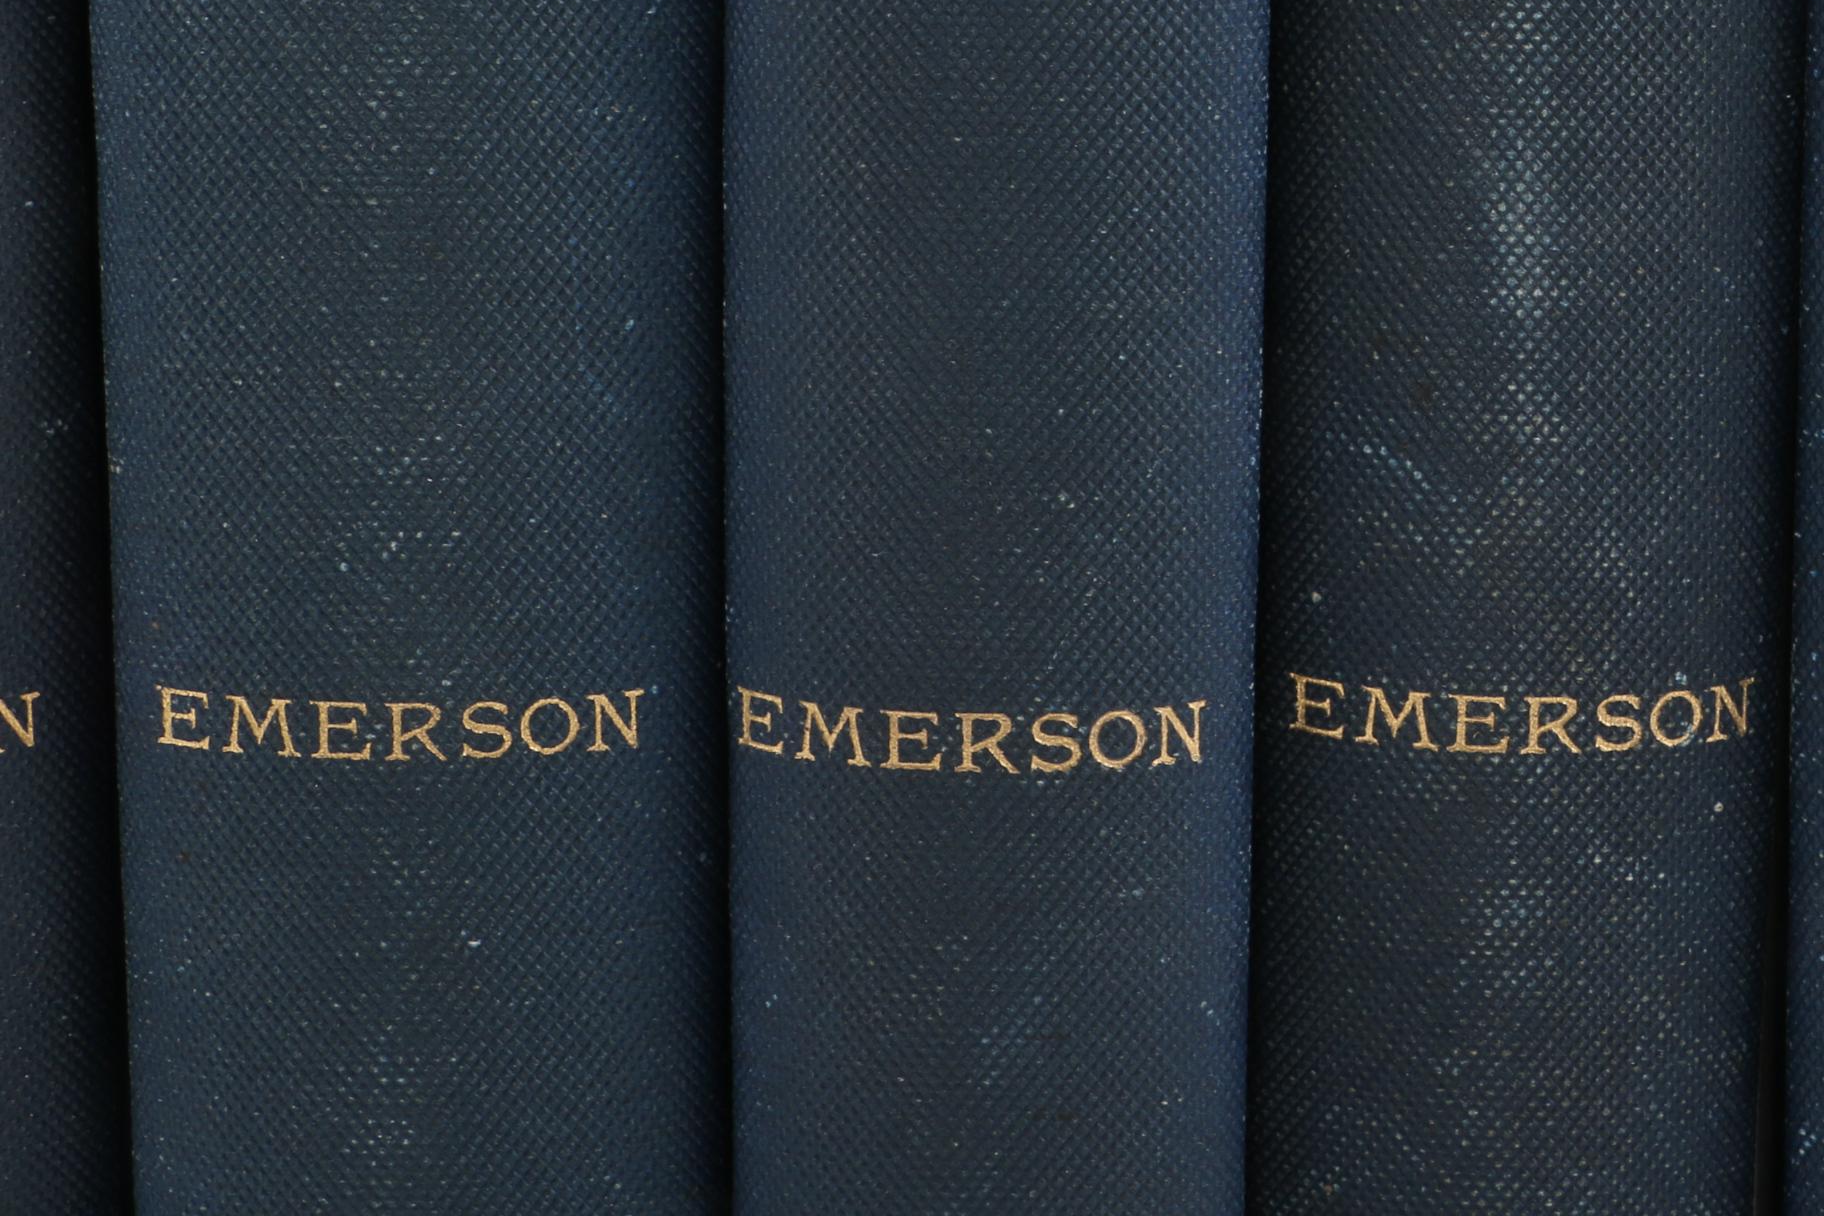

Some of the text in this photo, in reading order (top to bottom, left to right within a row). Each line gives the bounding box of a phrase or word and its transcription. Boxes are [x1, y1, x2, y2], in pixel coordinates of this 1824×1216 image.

[155, 684, 645, 762] EMERSON
[737, 686, 1207, 773] EMERSON
[1289, 672, 1755, 756] EMERSON
